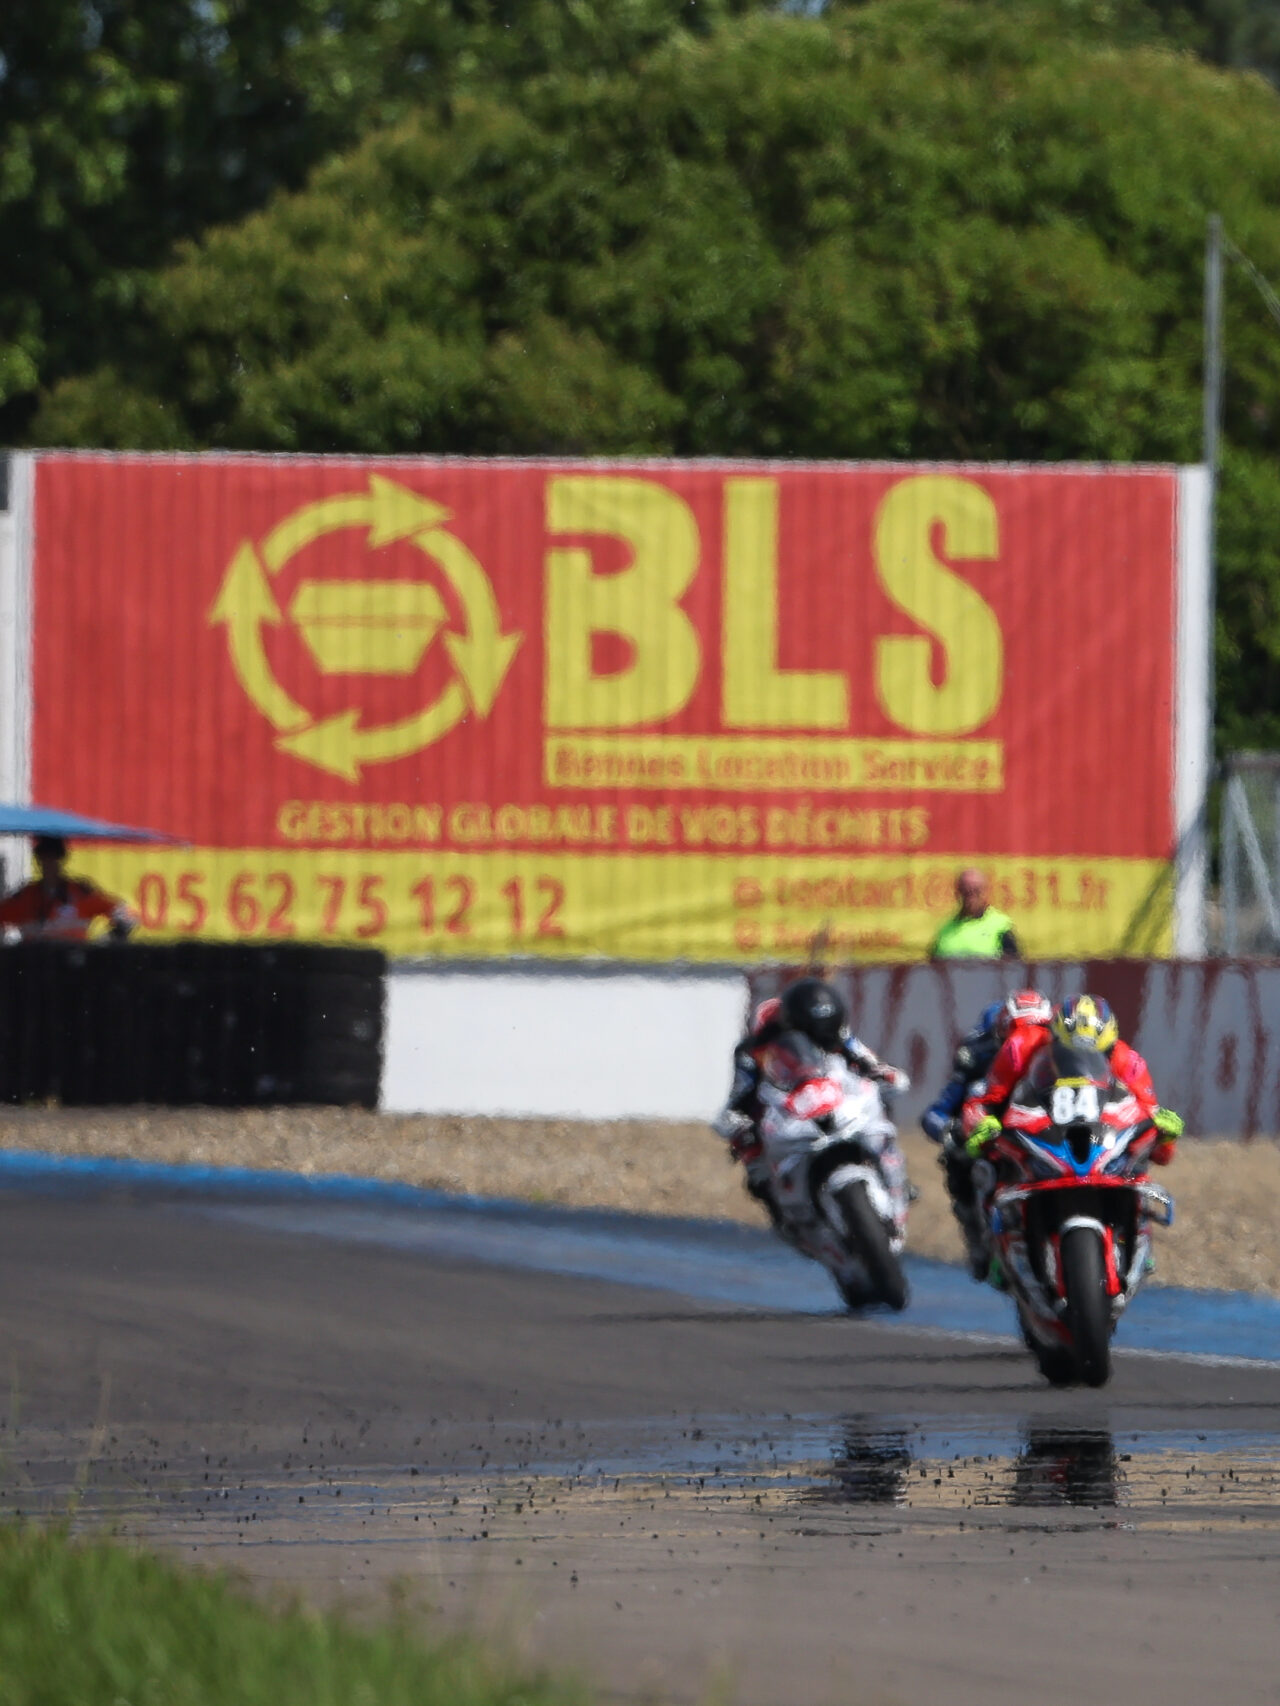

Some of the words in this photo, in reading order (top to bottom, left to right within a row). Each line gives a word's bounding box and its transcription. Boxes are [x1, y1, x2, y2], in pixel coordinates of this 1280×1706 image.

[545, 473, 1003, 736] BLS
[699, 748, 852, 780] Location
[860, 749, 991, 782] Service
[278, 800, 443, 842] GESTION
[451, 802, 618, 844] GLOBALE
[626, 804, 674, 846] DE
[679, 804, 760, 846] VOS
[764, 797, 931, 848] DÉCHETS
[135, 871, 210, 931] 05
[226, 870, 296, 936] 62
[316, 872, 389, 939] 75
[409, 872, 477, 937] 12
[501, 873, 566, 938] 12
[1053, 1086, 1100, 1125] 84
